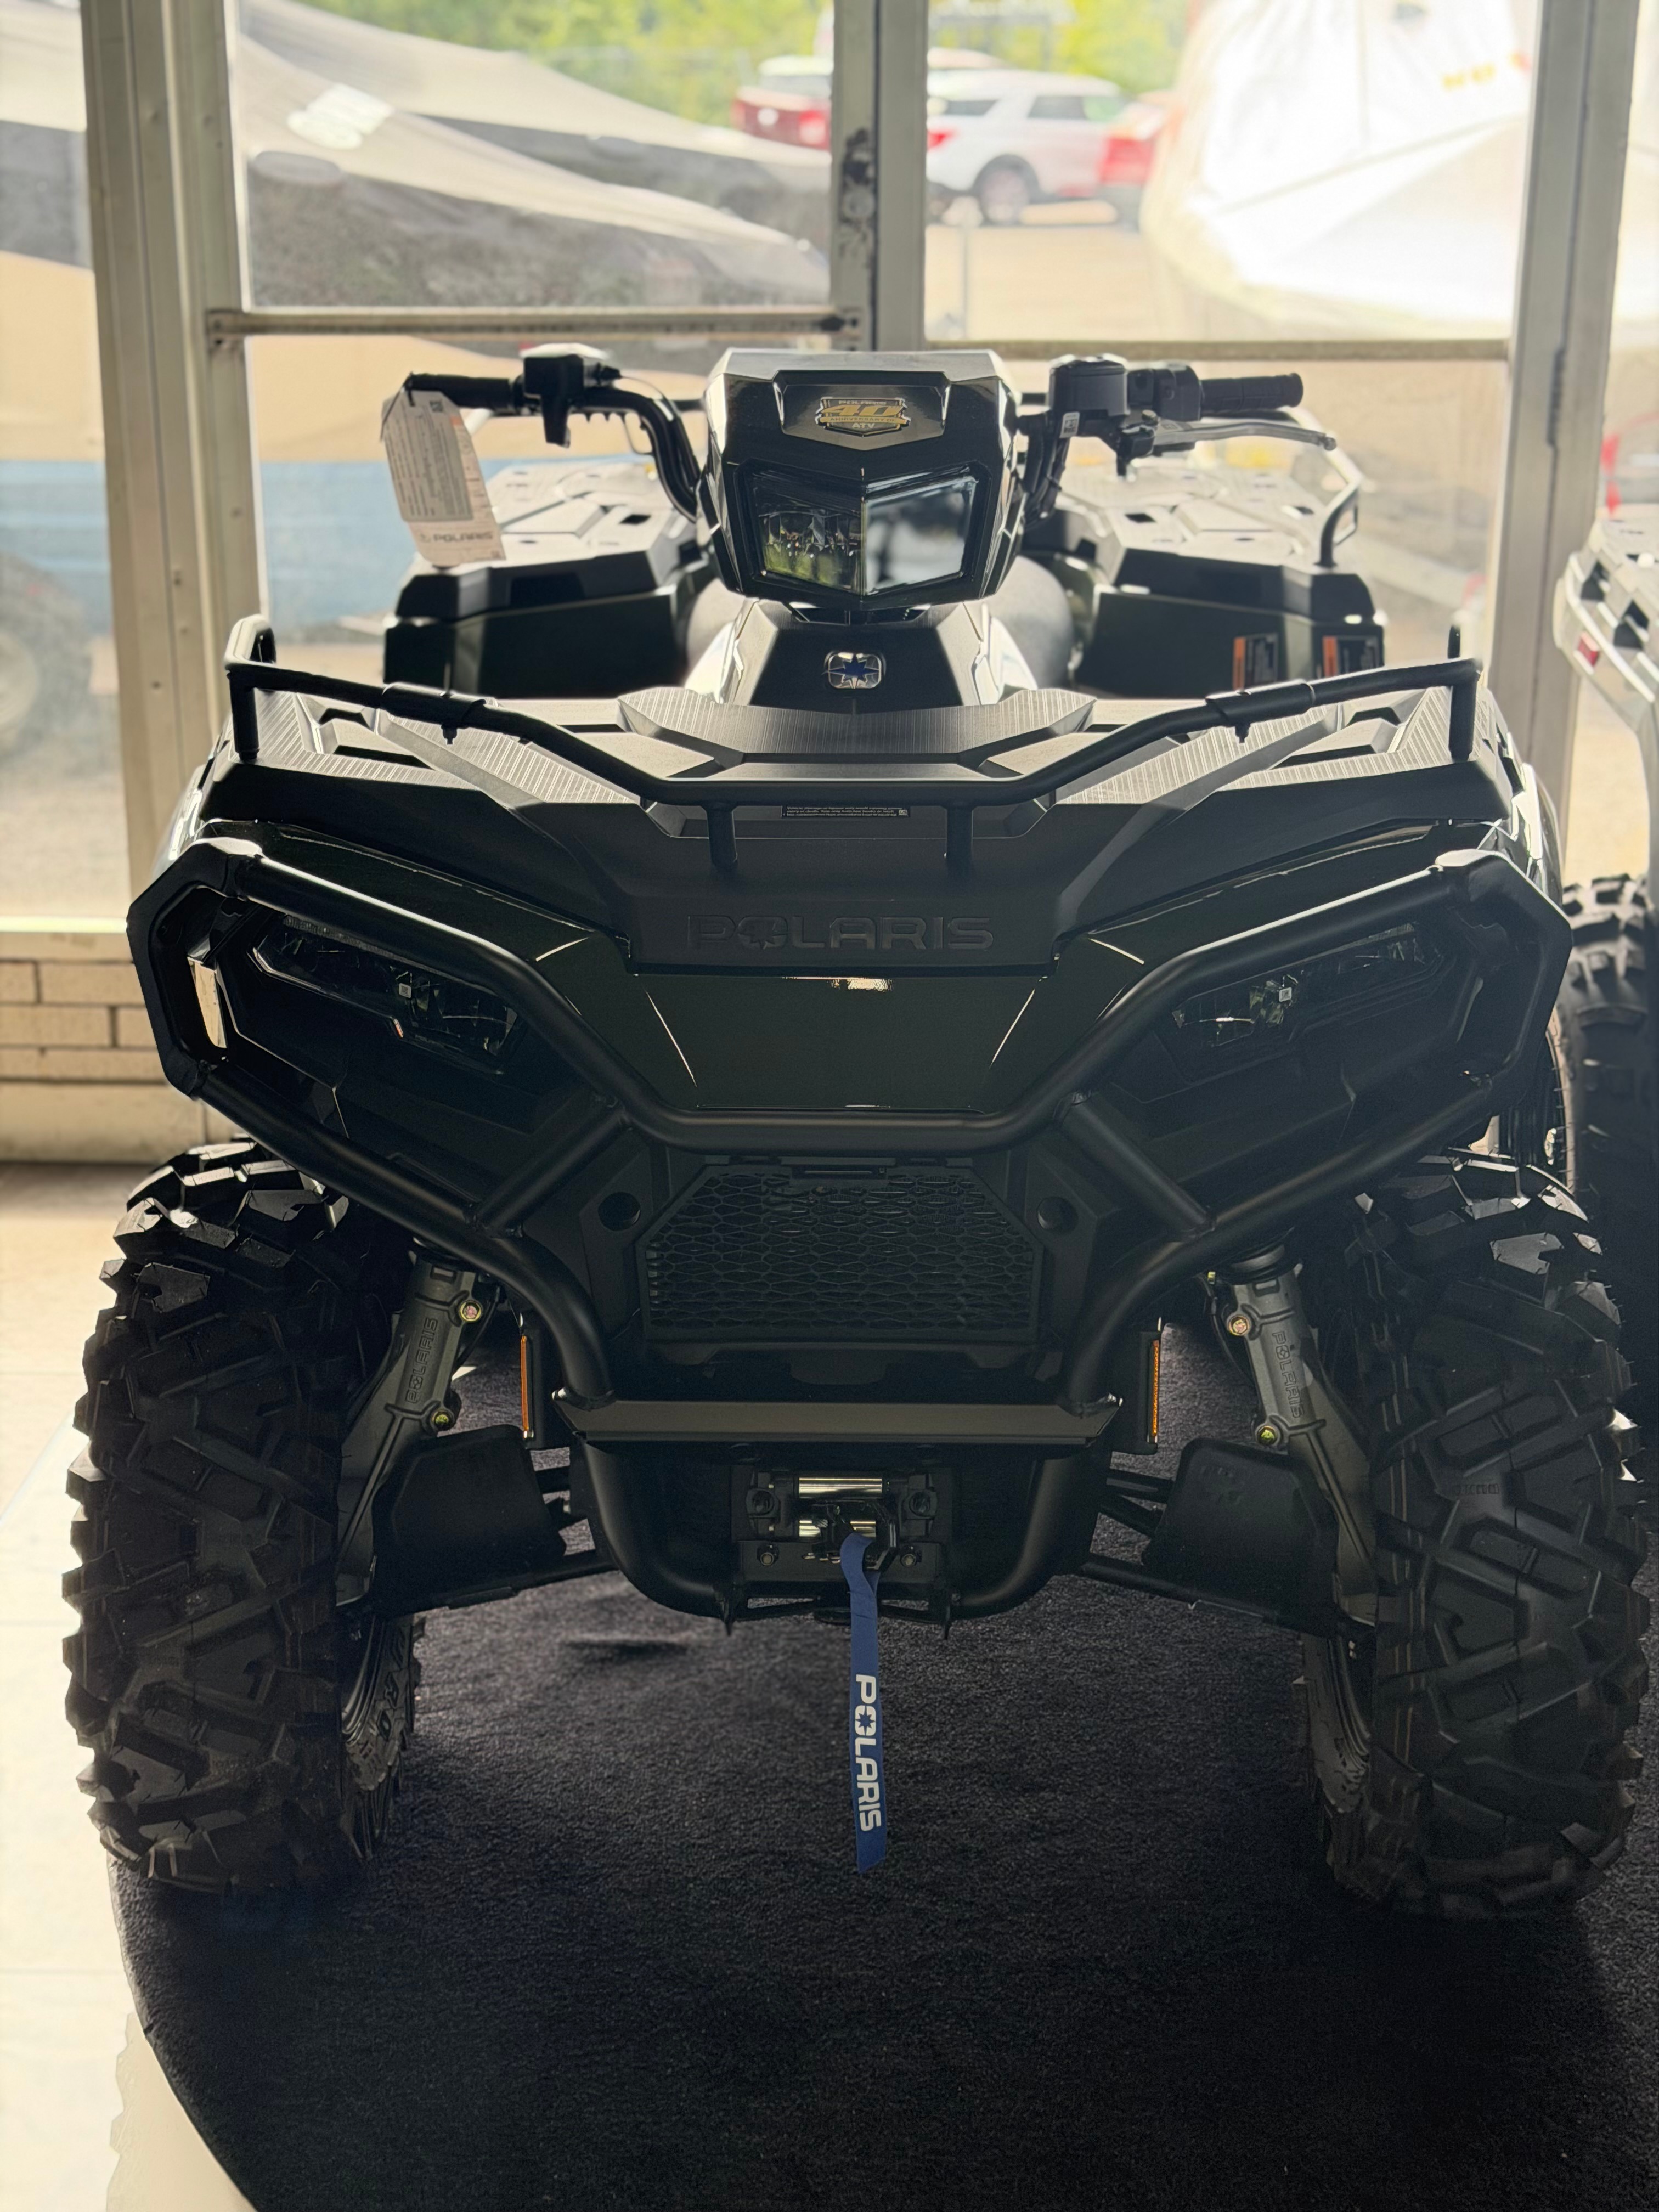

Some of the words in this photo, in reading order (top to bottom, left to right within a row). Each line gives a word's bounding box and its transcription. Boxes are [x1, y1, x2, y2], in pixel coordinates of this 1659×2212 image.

[821, 404, 903, 416] 40
[687, 915, 994, 950] POLARIS
[405, 1318, 438, 1404] POLARIS
[1272, 1331, 1304, 1418] POLARIS
[854, 1674, 882, 1832] POLARIS
